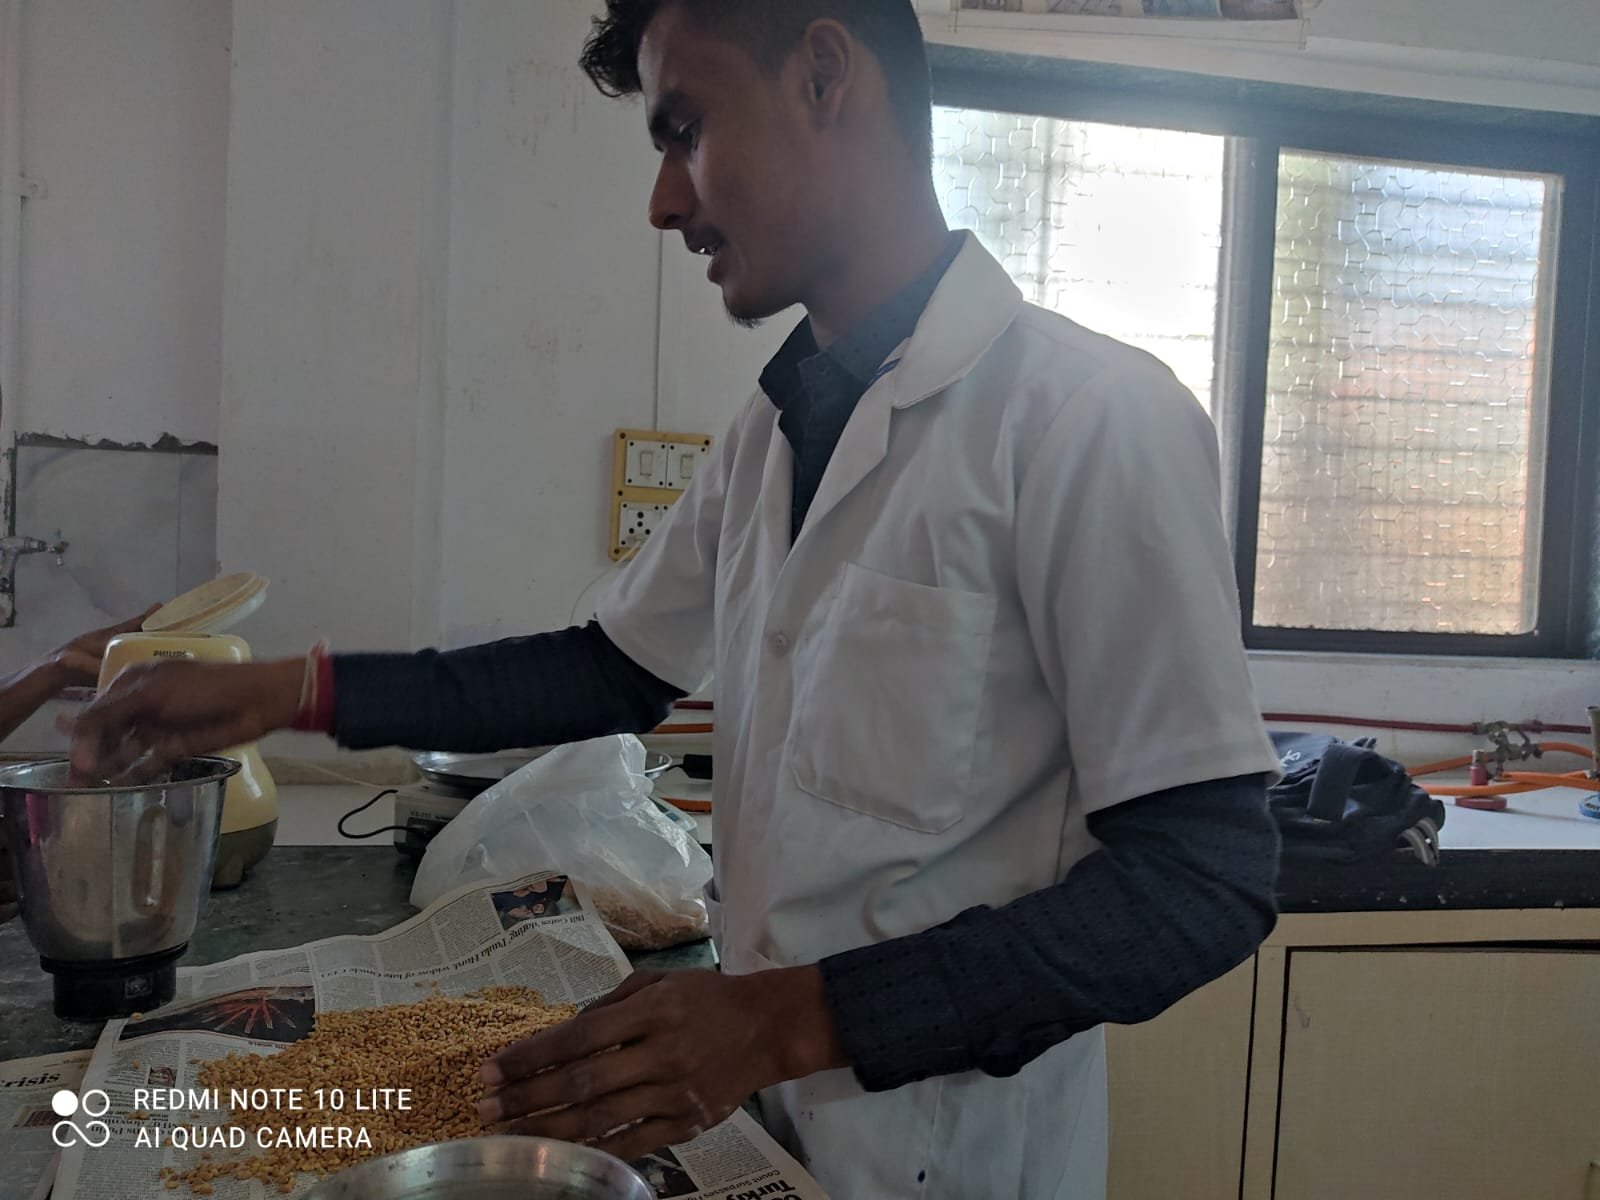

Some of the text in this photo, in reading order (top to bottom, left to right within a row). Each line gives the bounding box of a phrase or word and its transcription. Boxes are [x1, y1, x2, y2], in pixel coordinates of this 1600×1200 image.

[481, 937, 507, 957] Paula
[751, 1169, 781, 1183] Count
[703, 1180, 752, 1198] Surpasses
